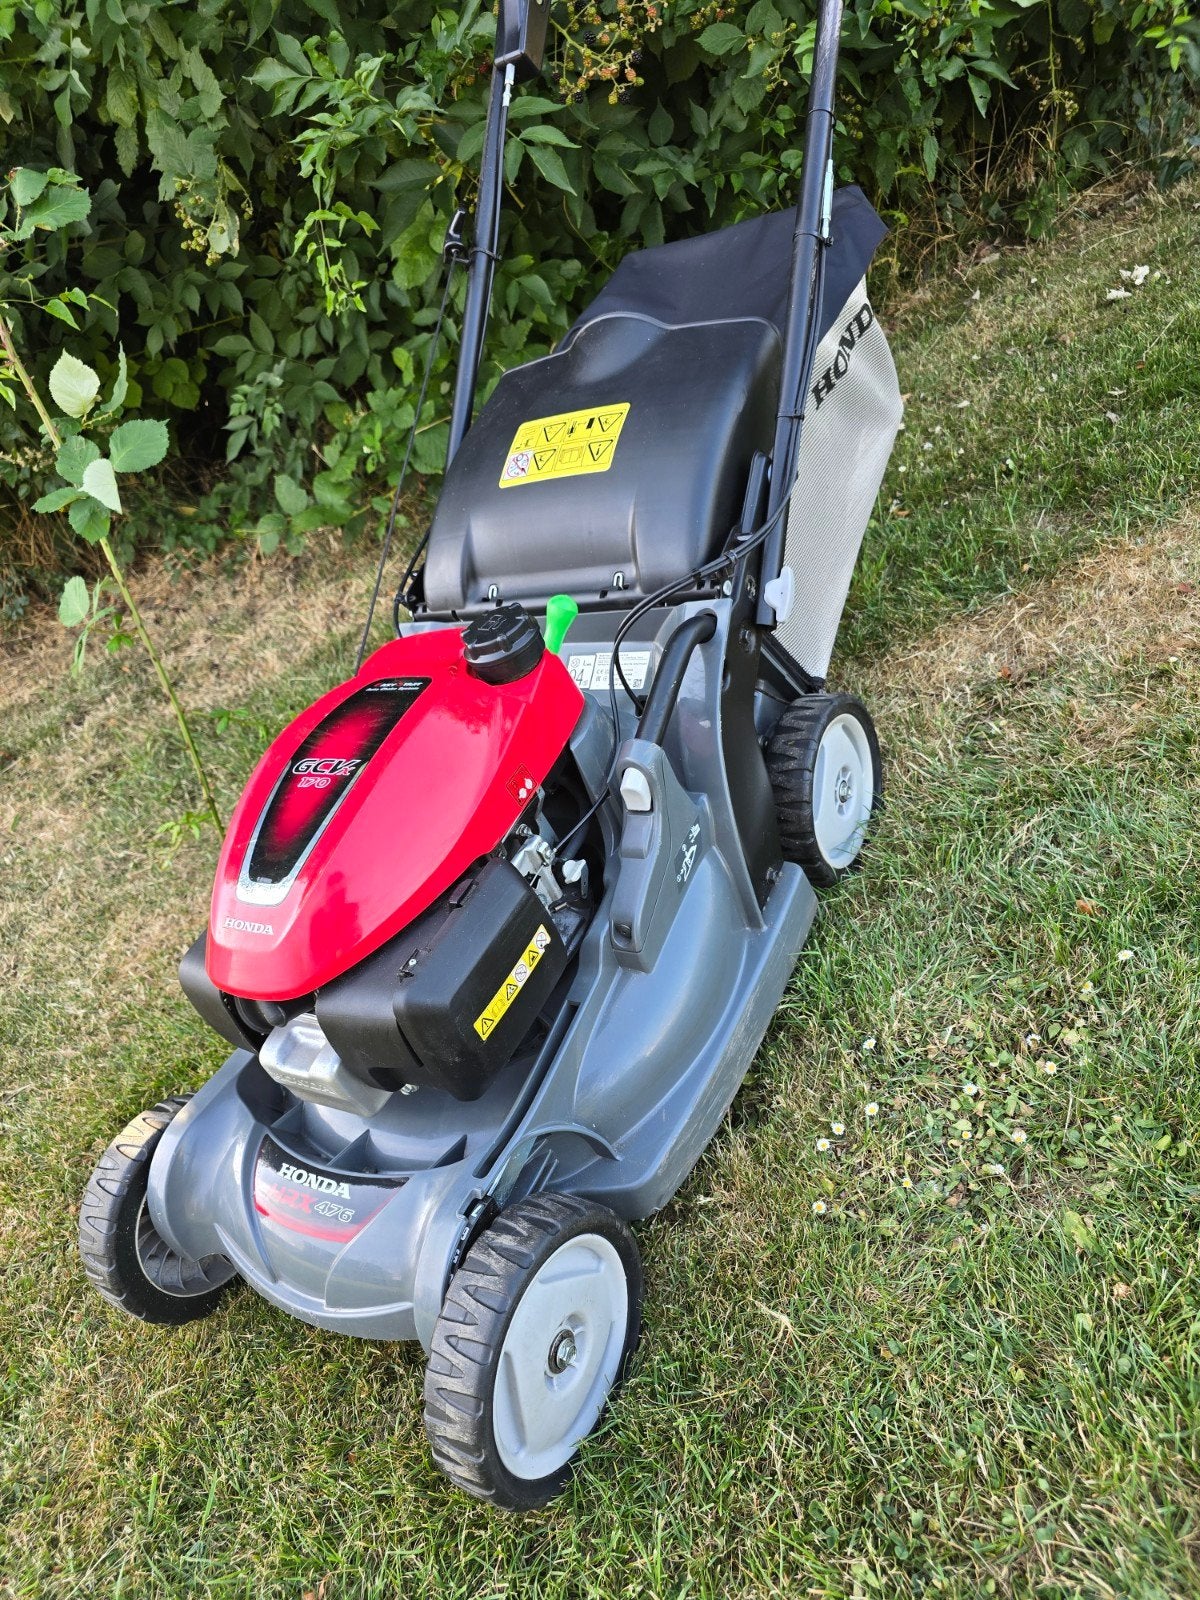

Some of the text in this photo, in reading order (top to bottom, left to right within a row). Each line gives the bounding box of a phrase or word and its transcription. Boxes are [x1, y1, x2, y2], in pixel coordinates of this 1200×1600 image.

[297, 776, 331, 788] 170
[223, 917, 274, 936] HONDA
[279, 1162, 351, 1200] HONDA
[314, 1200, 355, 1223] 476
